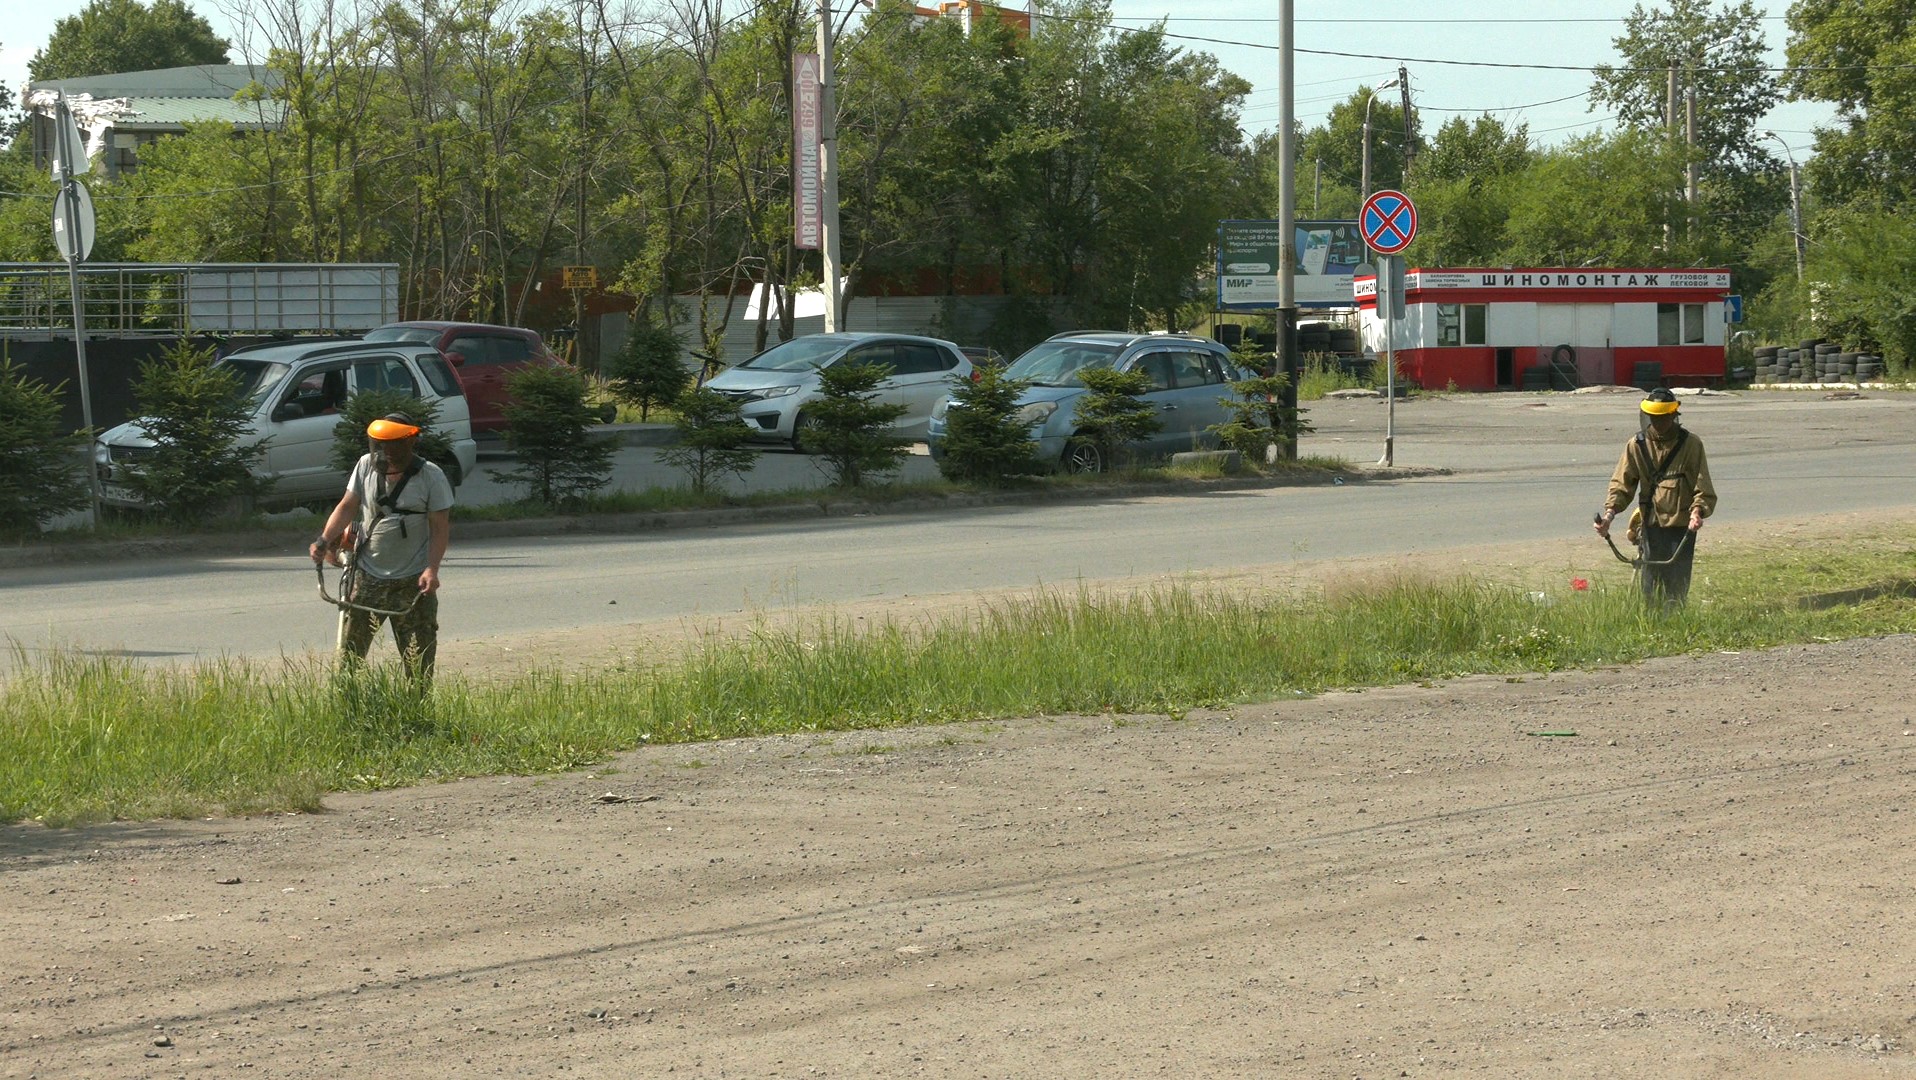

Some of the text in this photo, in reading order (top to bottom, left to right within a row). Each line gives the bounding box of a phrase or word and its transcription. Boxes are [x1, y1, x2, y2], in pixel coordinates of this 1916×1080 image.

[801, 70, 817, 246] АВТОМОЙКА 662-100
[1226, 278, 1253, 288] МИР
[1482, 274, 1659, 286] ШИНОМОНТАЖ
